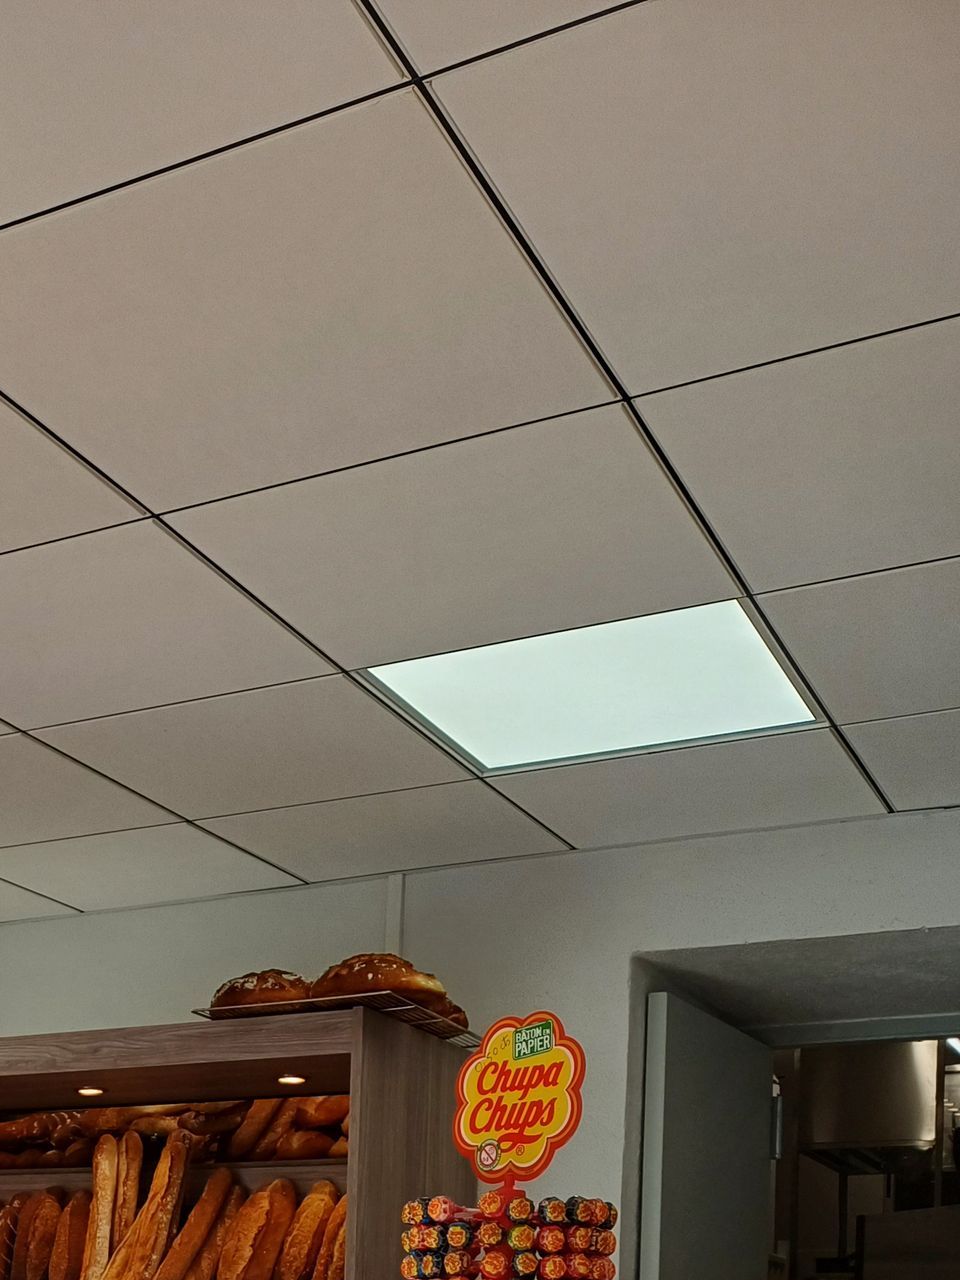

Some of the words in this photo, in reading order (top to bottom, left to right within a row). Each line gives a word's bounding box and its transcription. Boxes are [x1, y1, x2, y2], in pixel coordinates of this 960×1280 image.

[515, 1036, 551, 1058] PAPIER
[476, 1060, 565, 1100] Chupa
[469, 1095, 558, 1140] Chups
